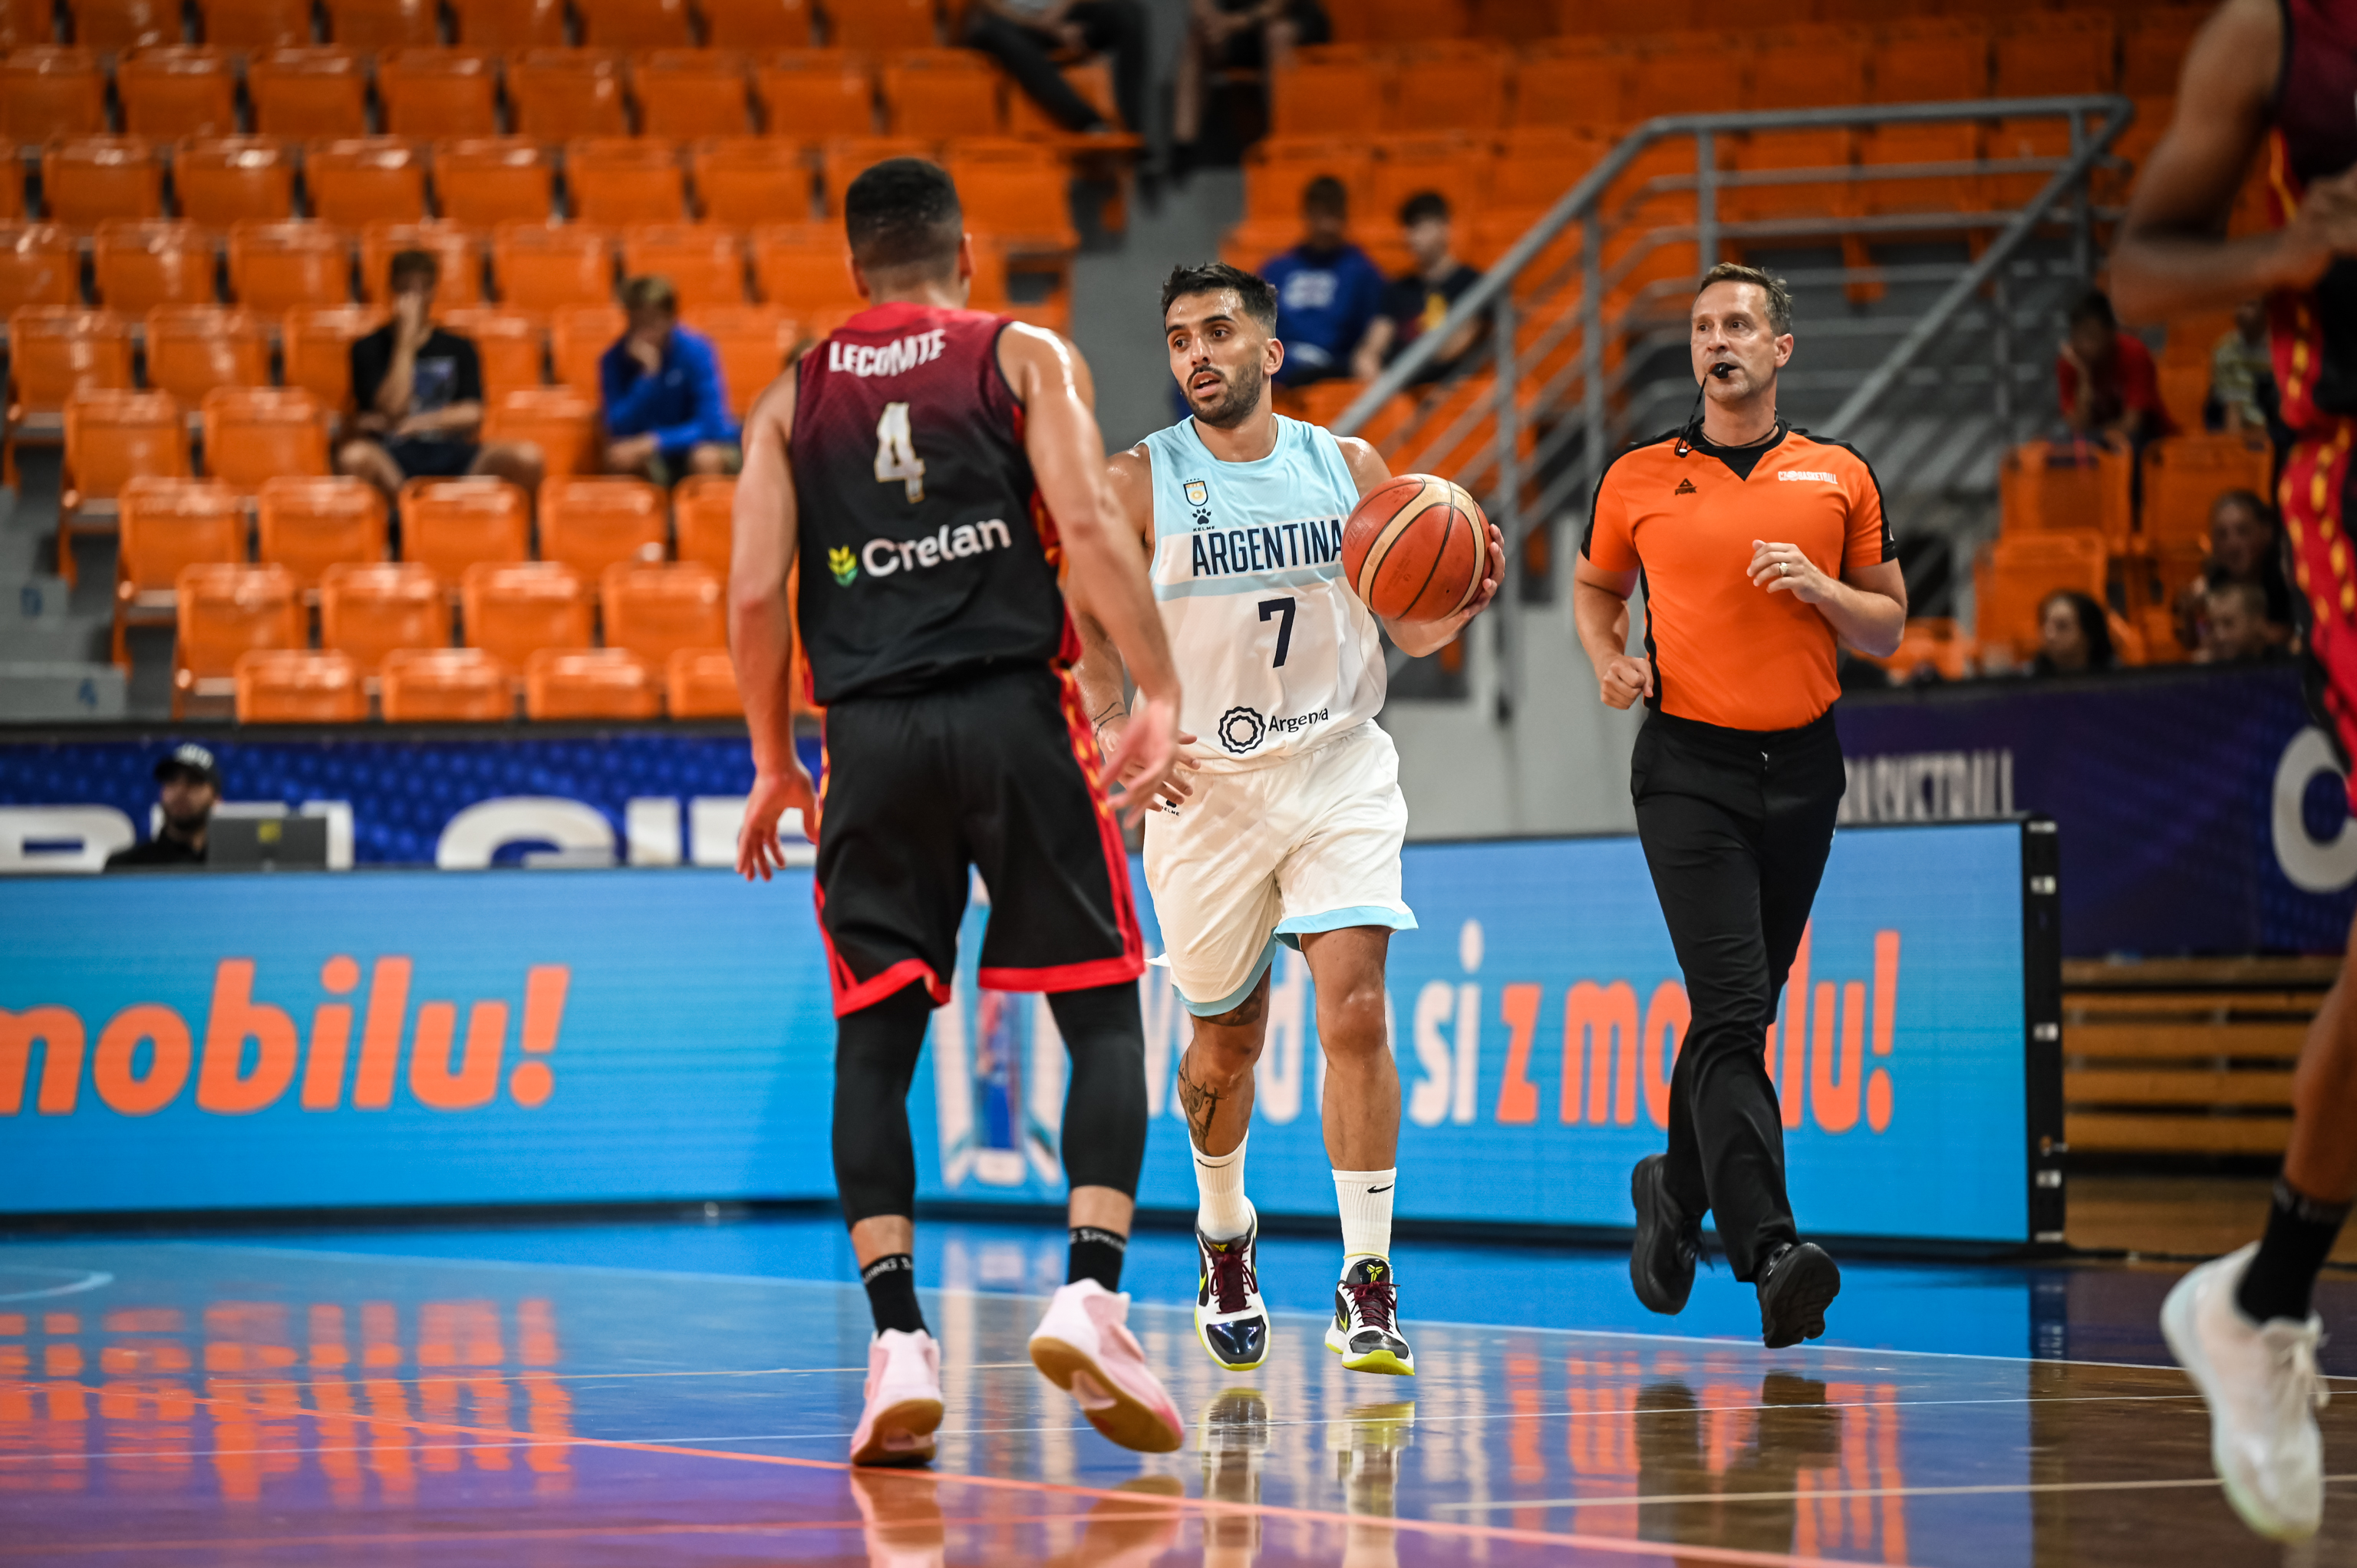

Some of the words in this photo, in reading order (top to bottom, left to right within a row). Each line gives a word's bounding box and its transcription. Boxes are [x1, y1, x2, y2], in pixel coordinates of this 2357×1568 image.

[829, 329, 946, 377] LECOMTE
[874, 401, 926, 504] 4
[862, 519, 1011, 577] Crelan
[1192, 519, 1343, 577] ARGENTINA
[1258, 597, 1296, 668] 7
[1408, 918, 1484, 1128] si
[1495, 981, 1543, 1125] z
[1559, 915, 1901, 1135] molu!
